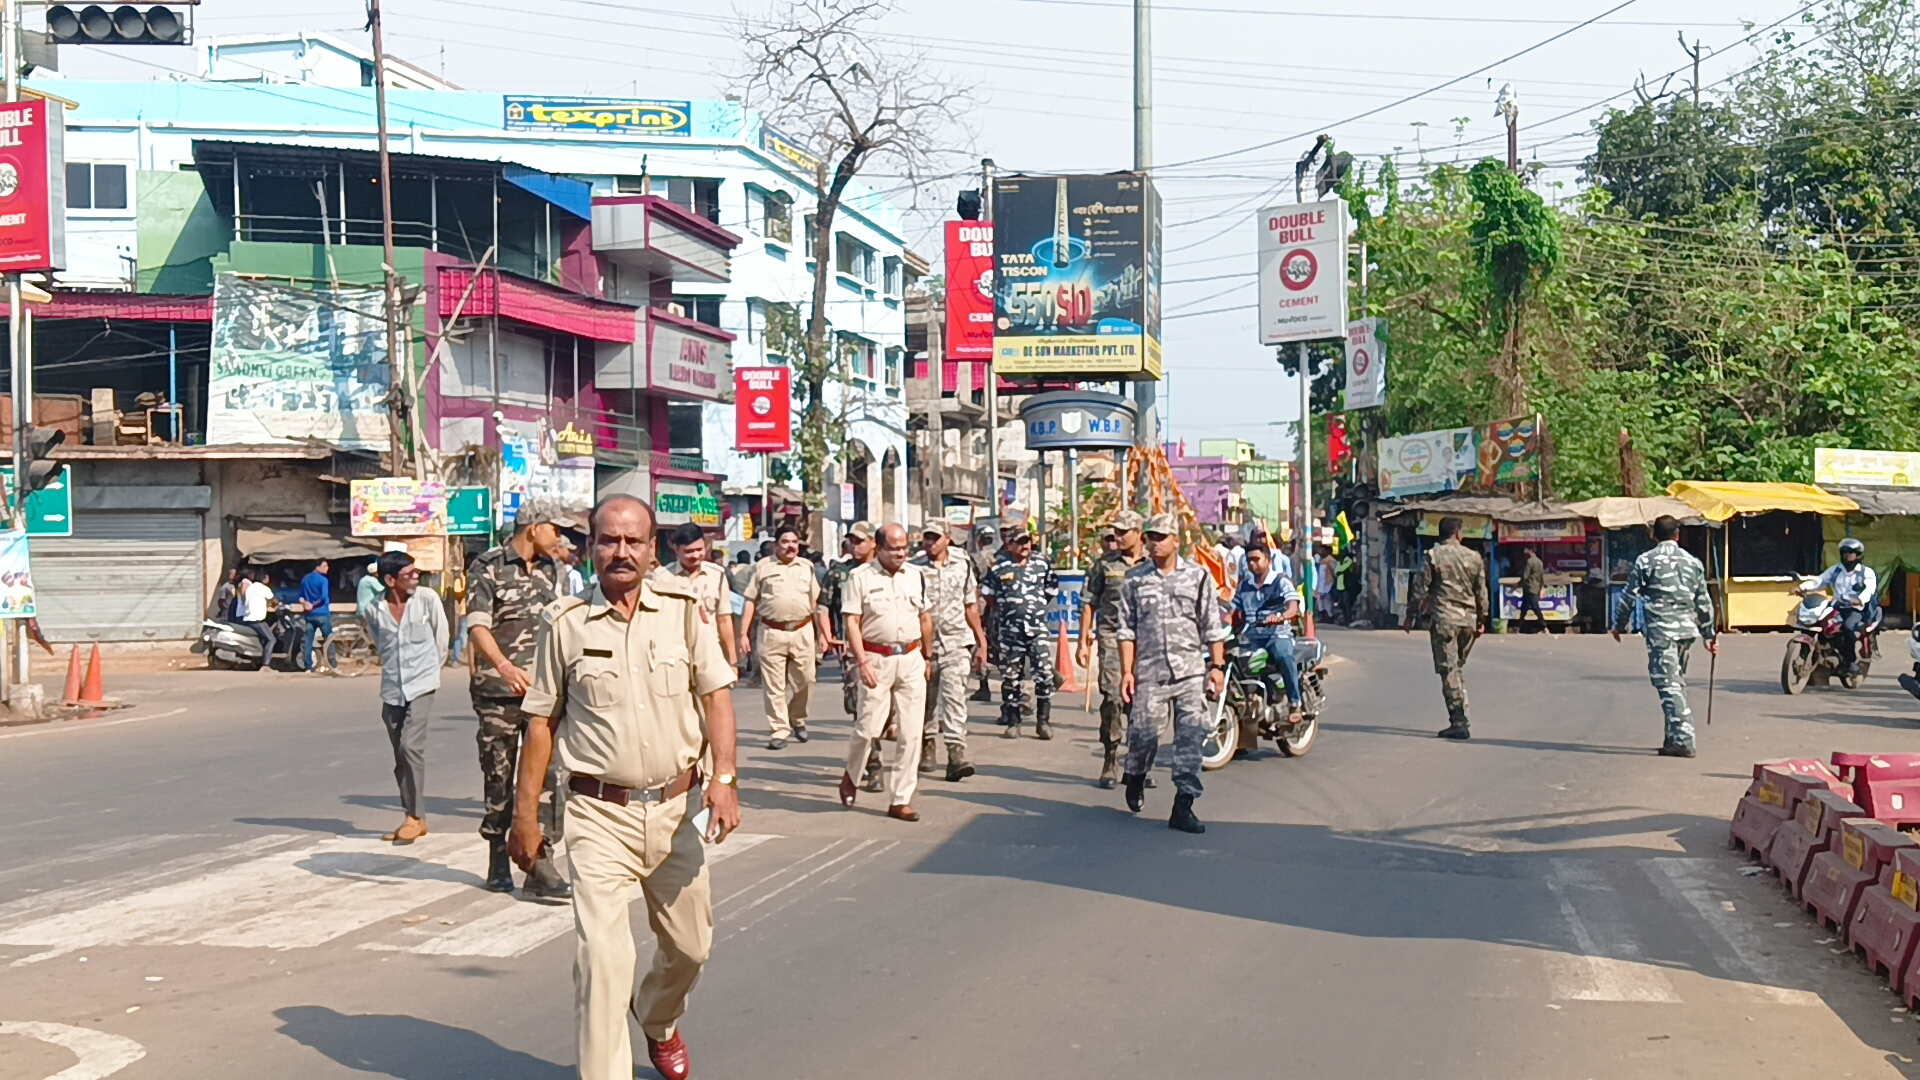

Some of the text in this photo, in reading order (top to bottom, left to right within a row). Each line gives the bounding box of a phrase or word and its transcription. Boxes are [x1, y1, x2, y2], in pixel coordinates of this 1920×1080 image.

[531, 104, 674, 127] texprint
[1268, 209, 1325, 231] DOUBLE
[1279, 227, 1316, 244] BULL
[1000, 253, 1035, 264] TATA
[1000, 266, 1048, 277] TISCON
[1279, 295, 1319, 308] CEMENT
[1053, 345, 1100, 356] MARKETING
[275, 364, 317, 379] GREEN
[557, 421, 593, 443] Anis
